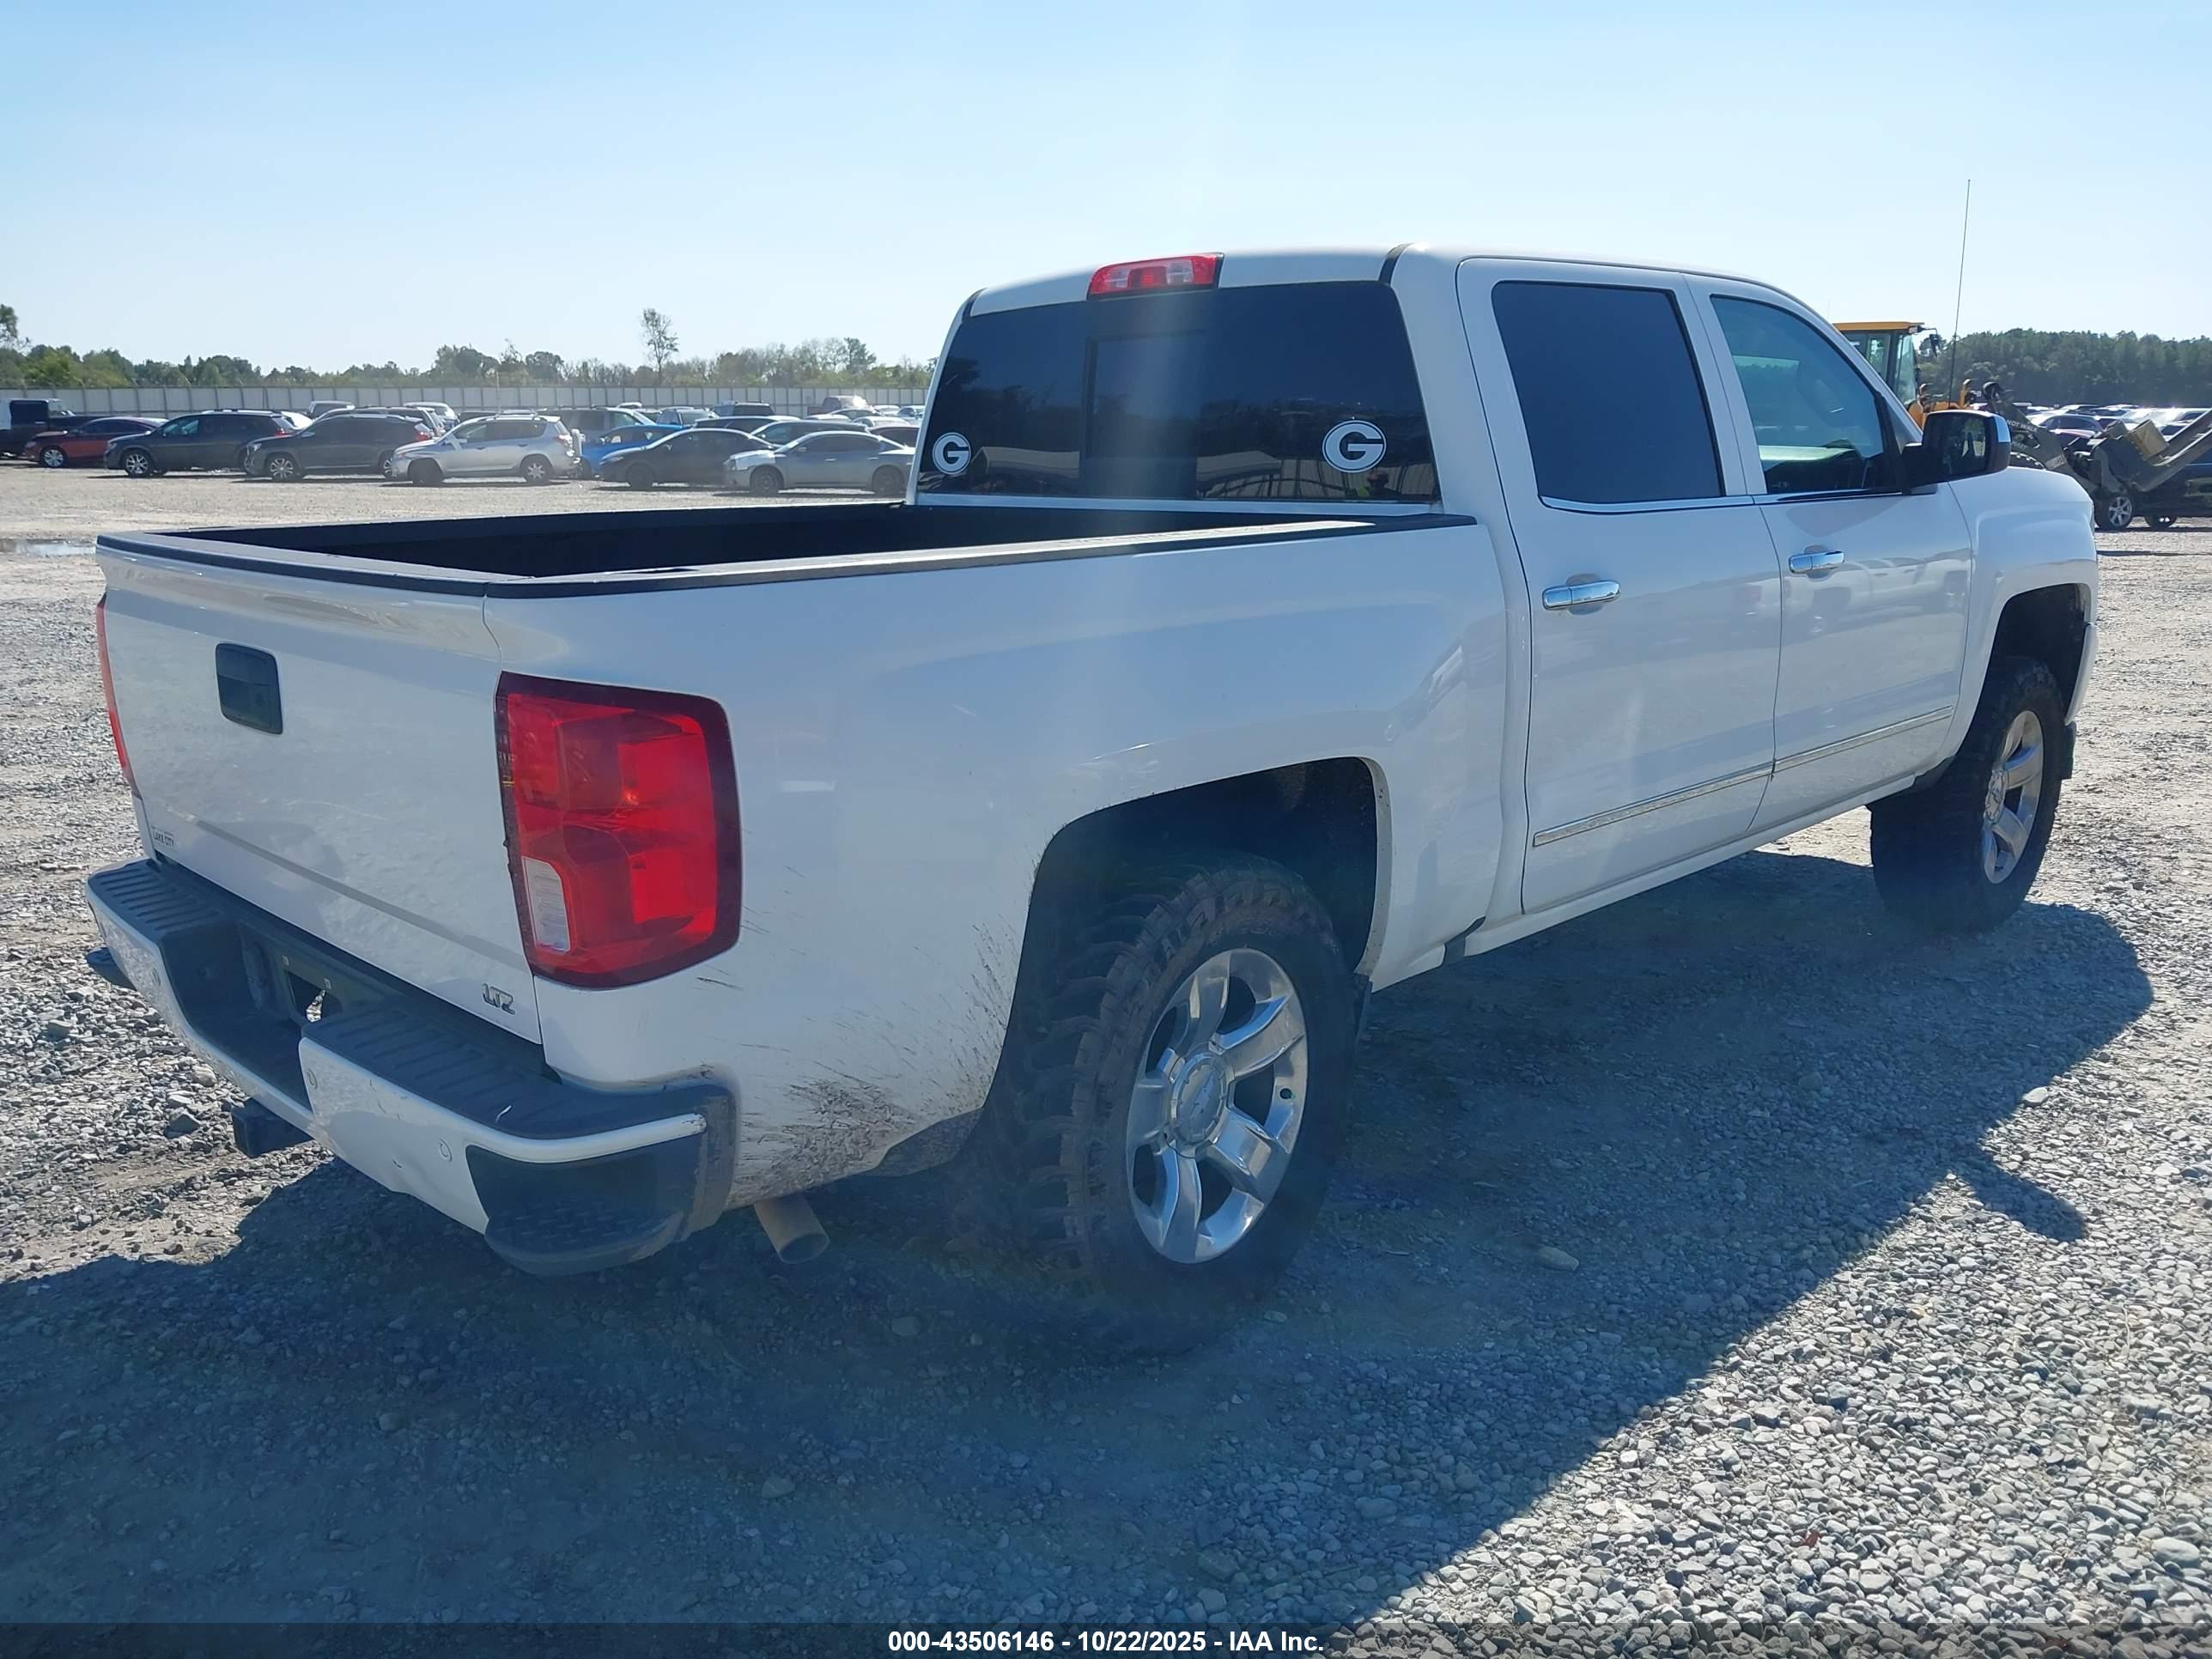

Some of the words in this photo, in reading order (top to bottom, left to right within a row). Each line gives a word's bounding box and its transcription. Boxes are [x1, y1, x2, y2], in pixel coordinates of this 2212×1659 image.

[933, 432, 971, 474] G
[1322, 420, 1387, 473] G
[482, 982, 516, 1015] LTZ
